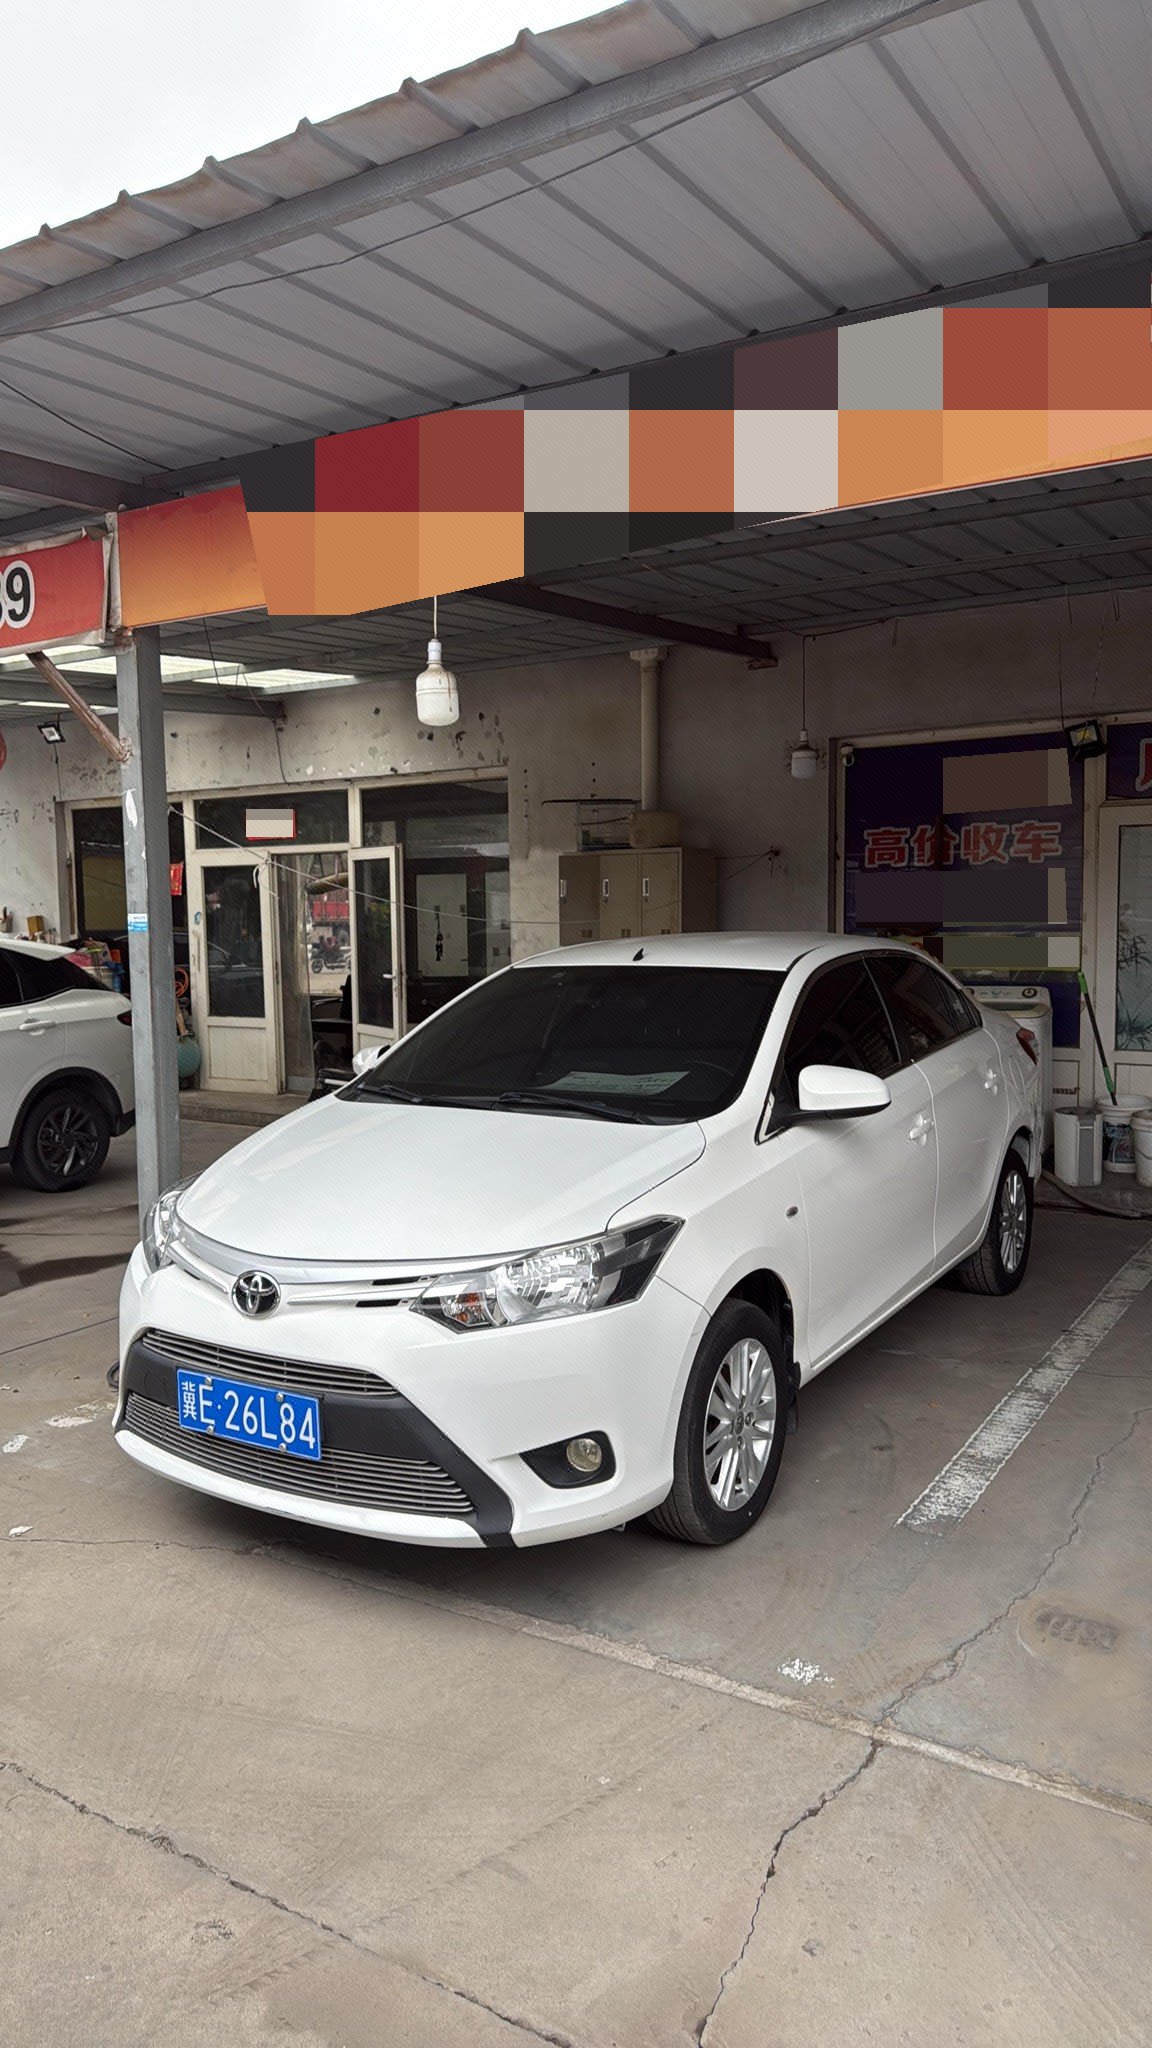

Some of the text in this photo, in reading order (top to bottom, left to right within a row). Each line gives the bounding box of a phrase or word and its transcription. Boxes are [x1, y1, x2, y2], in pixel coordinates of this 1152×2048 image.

[0, 562, 34, 627] 9
[865, 820, 1062, 867] 高价收车
